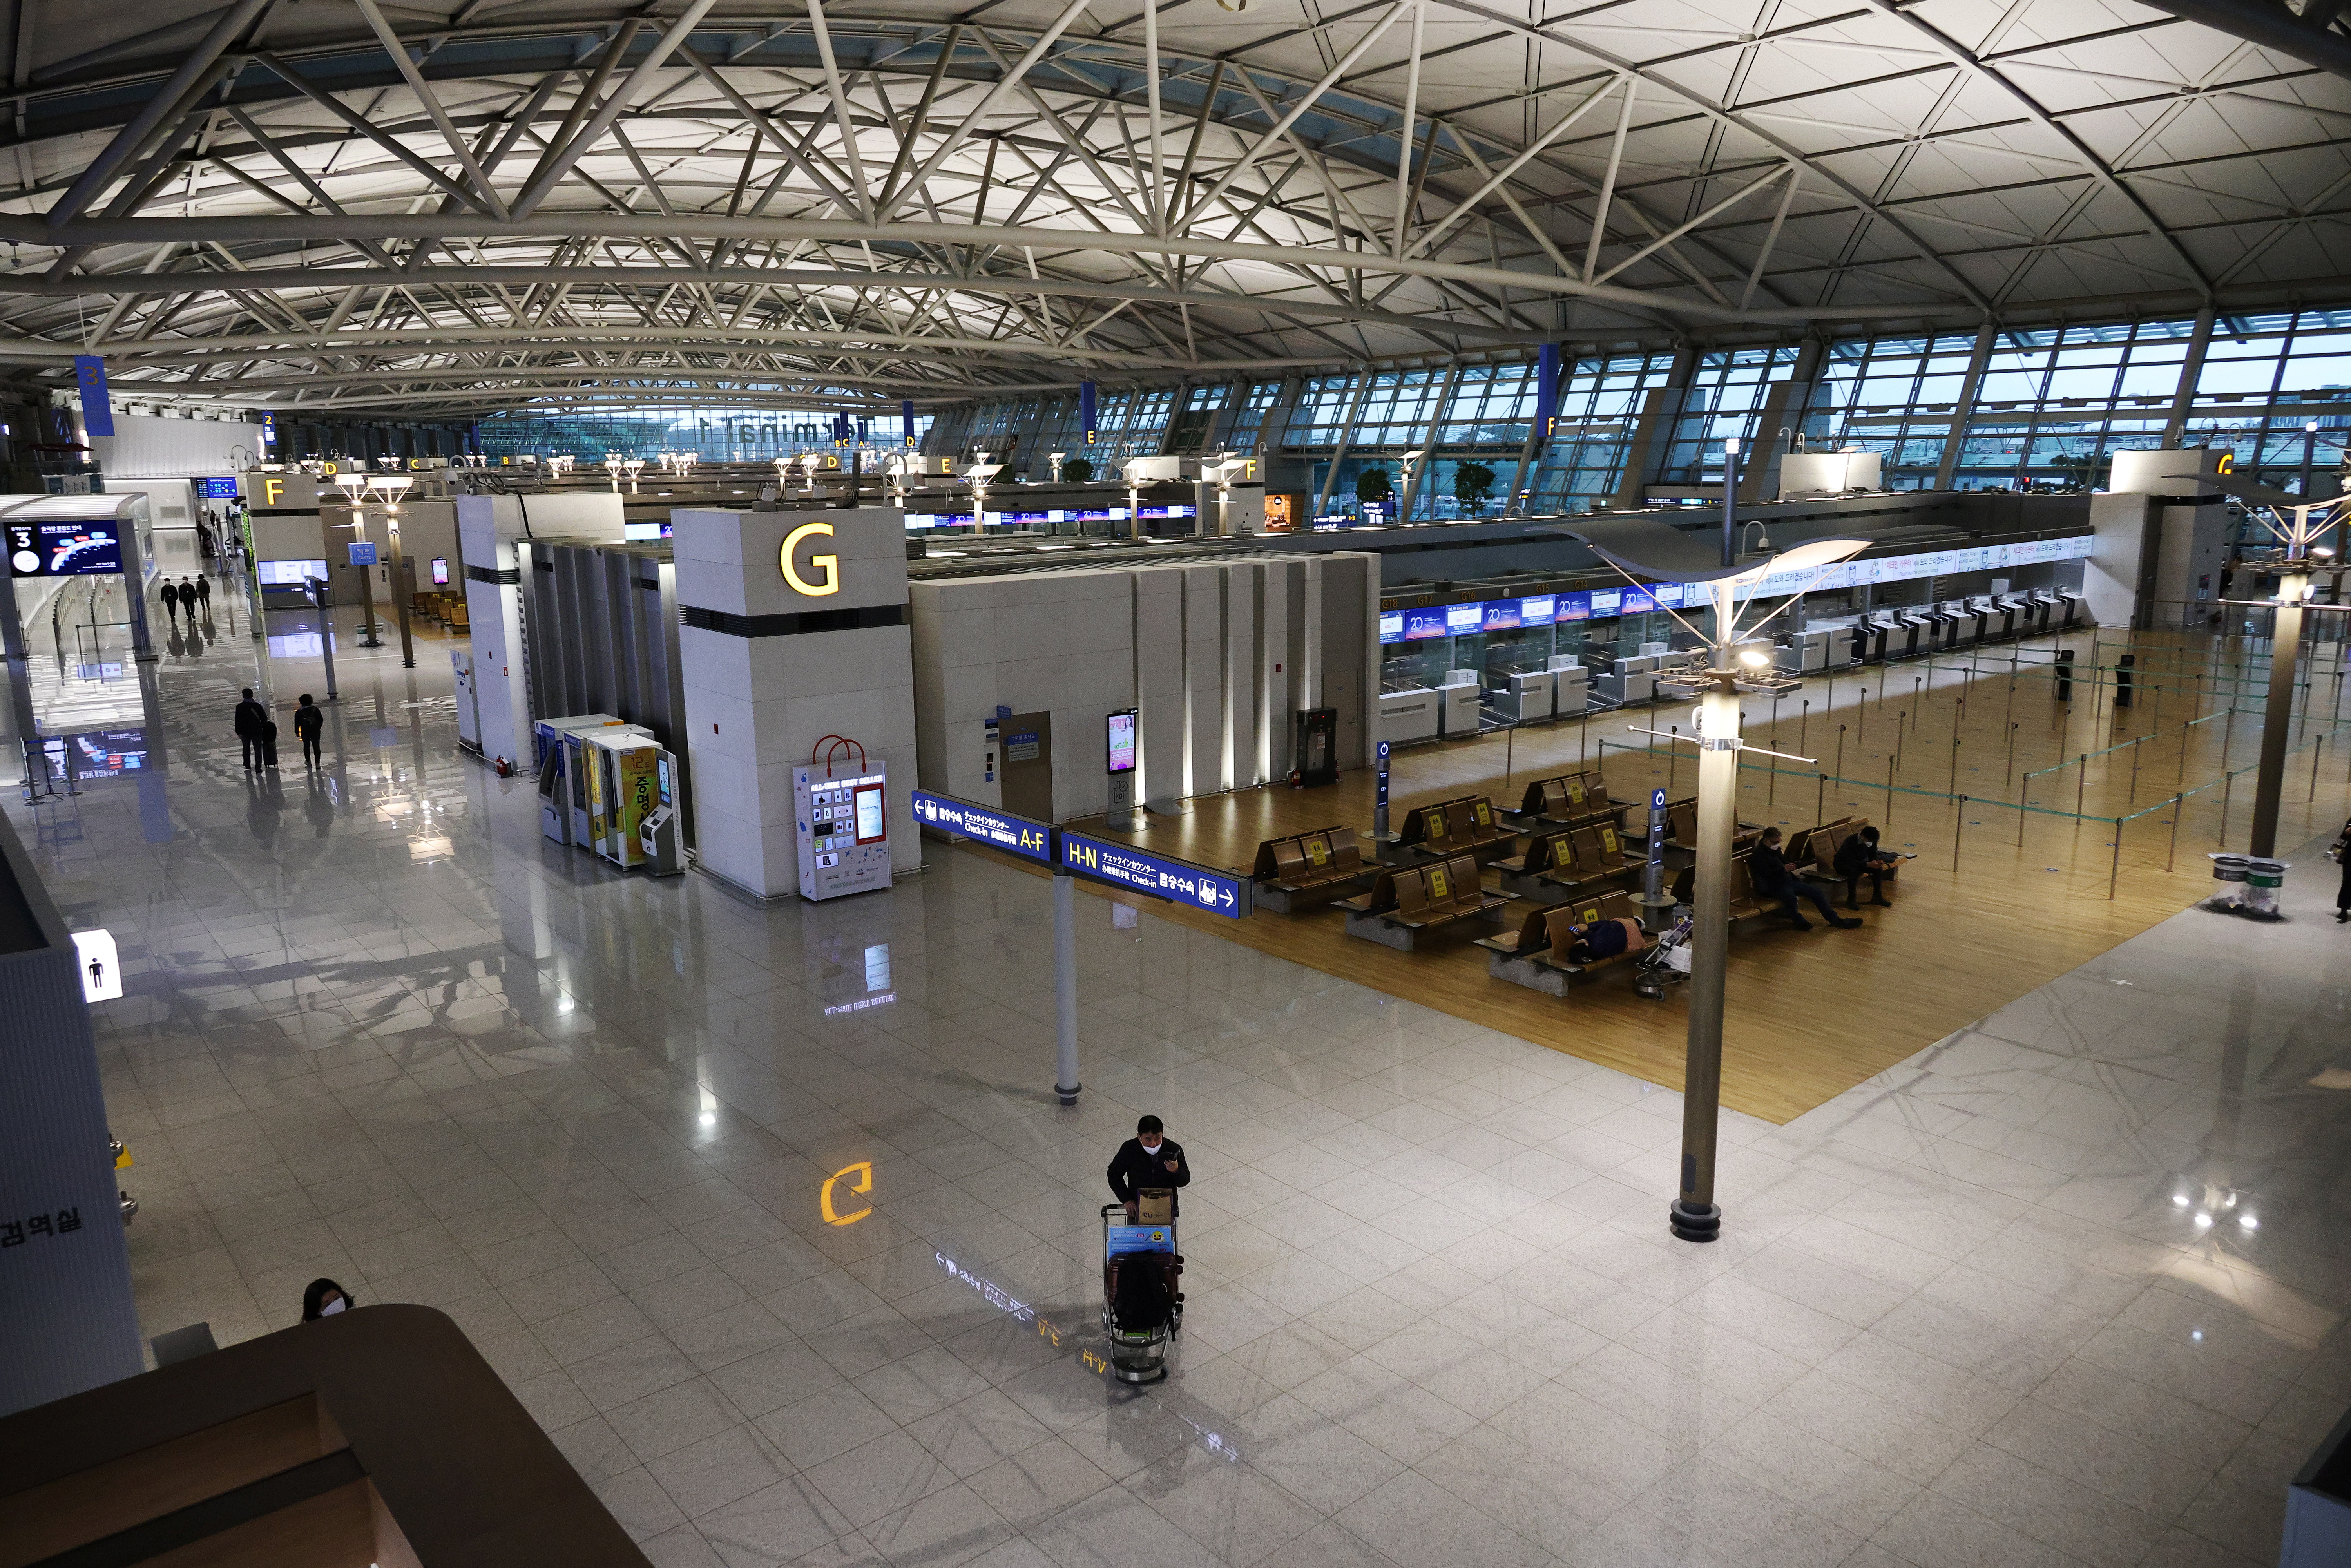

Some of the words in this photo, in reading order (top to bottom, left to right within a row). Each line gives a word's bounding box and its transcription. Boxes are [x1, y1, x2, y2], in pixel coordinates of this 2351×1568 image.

[84, 366, 98, 385] 3
[265, 416, 272, 424] 2
[1548, 417, 1555, 436] F
[843, 438, 849, 447] C
[906, 436, 915, 446] D
[1088, 431, 1094, 444] E
[325, 463, 337, 475] D
[411, 459, 419, 469] C
[828, 456, 838, 468] D
[942, 458, 951, 473] E
[1247, 460, 1256, 480] F
[266, 479, 284, 505] F
[16, 532, 31, 547] 3
[781, 523, 839, 596] G
[1574, 580, 1587, 588] G14
[1774, 574, 1784, 583] 도와
[1785, 571, 1815, 581] 드리겠습니다!
[1536, 583, 1549, 593] G15
[1418, 595, 1432, 605] G17
[1461, 591, 1476, 601] G16
[1626, 593, 1636, 605] 20
[1382, 599, 1398, 608] G18
[1559, 601, 1570, 613] 20
[1488, 608, 1500, 621] 20
[1410, 617, 1423, 630] 20
[811, 781, 840, 792] ALL-TIME
[841, 778, 858, 788] BEST
[859, 775, 883, 784] SELLER
[939, 808, 962, 825] 탑승수속
[964, 811, 1009, 829] チェックインカウンター
[965, 823, 988, 837] Check-in
[1020, 829, 1043, 851] A-F
[1069, 842, 1096, 869] H-N
[1103, 852, 1156, 873] チェックインカウンター
[1102, 864, 1130, 880] 办理乘机手续
[1132, 874, 1156, 889] Check-in
[1160, 872, 1194, 896] 탑승수속
[0, 1207, 82, 1248] 검역실
